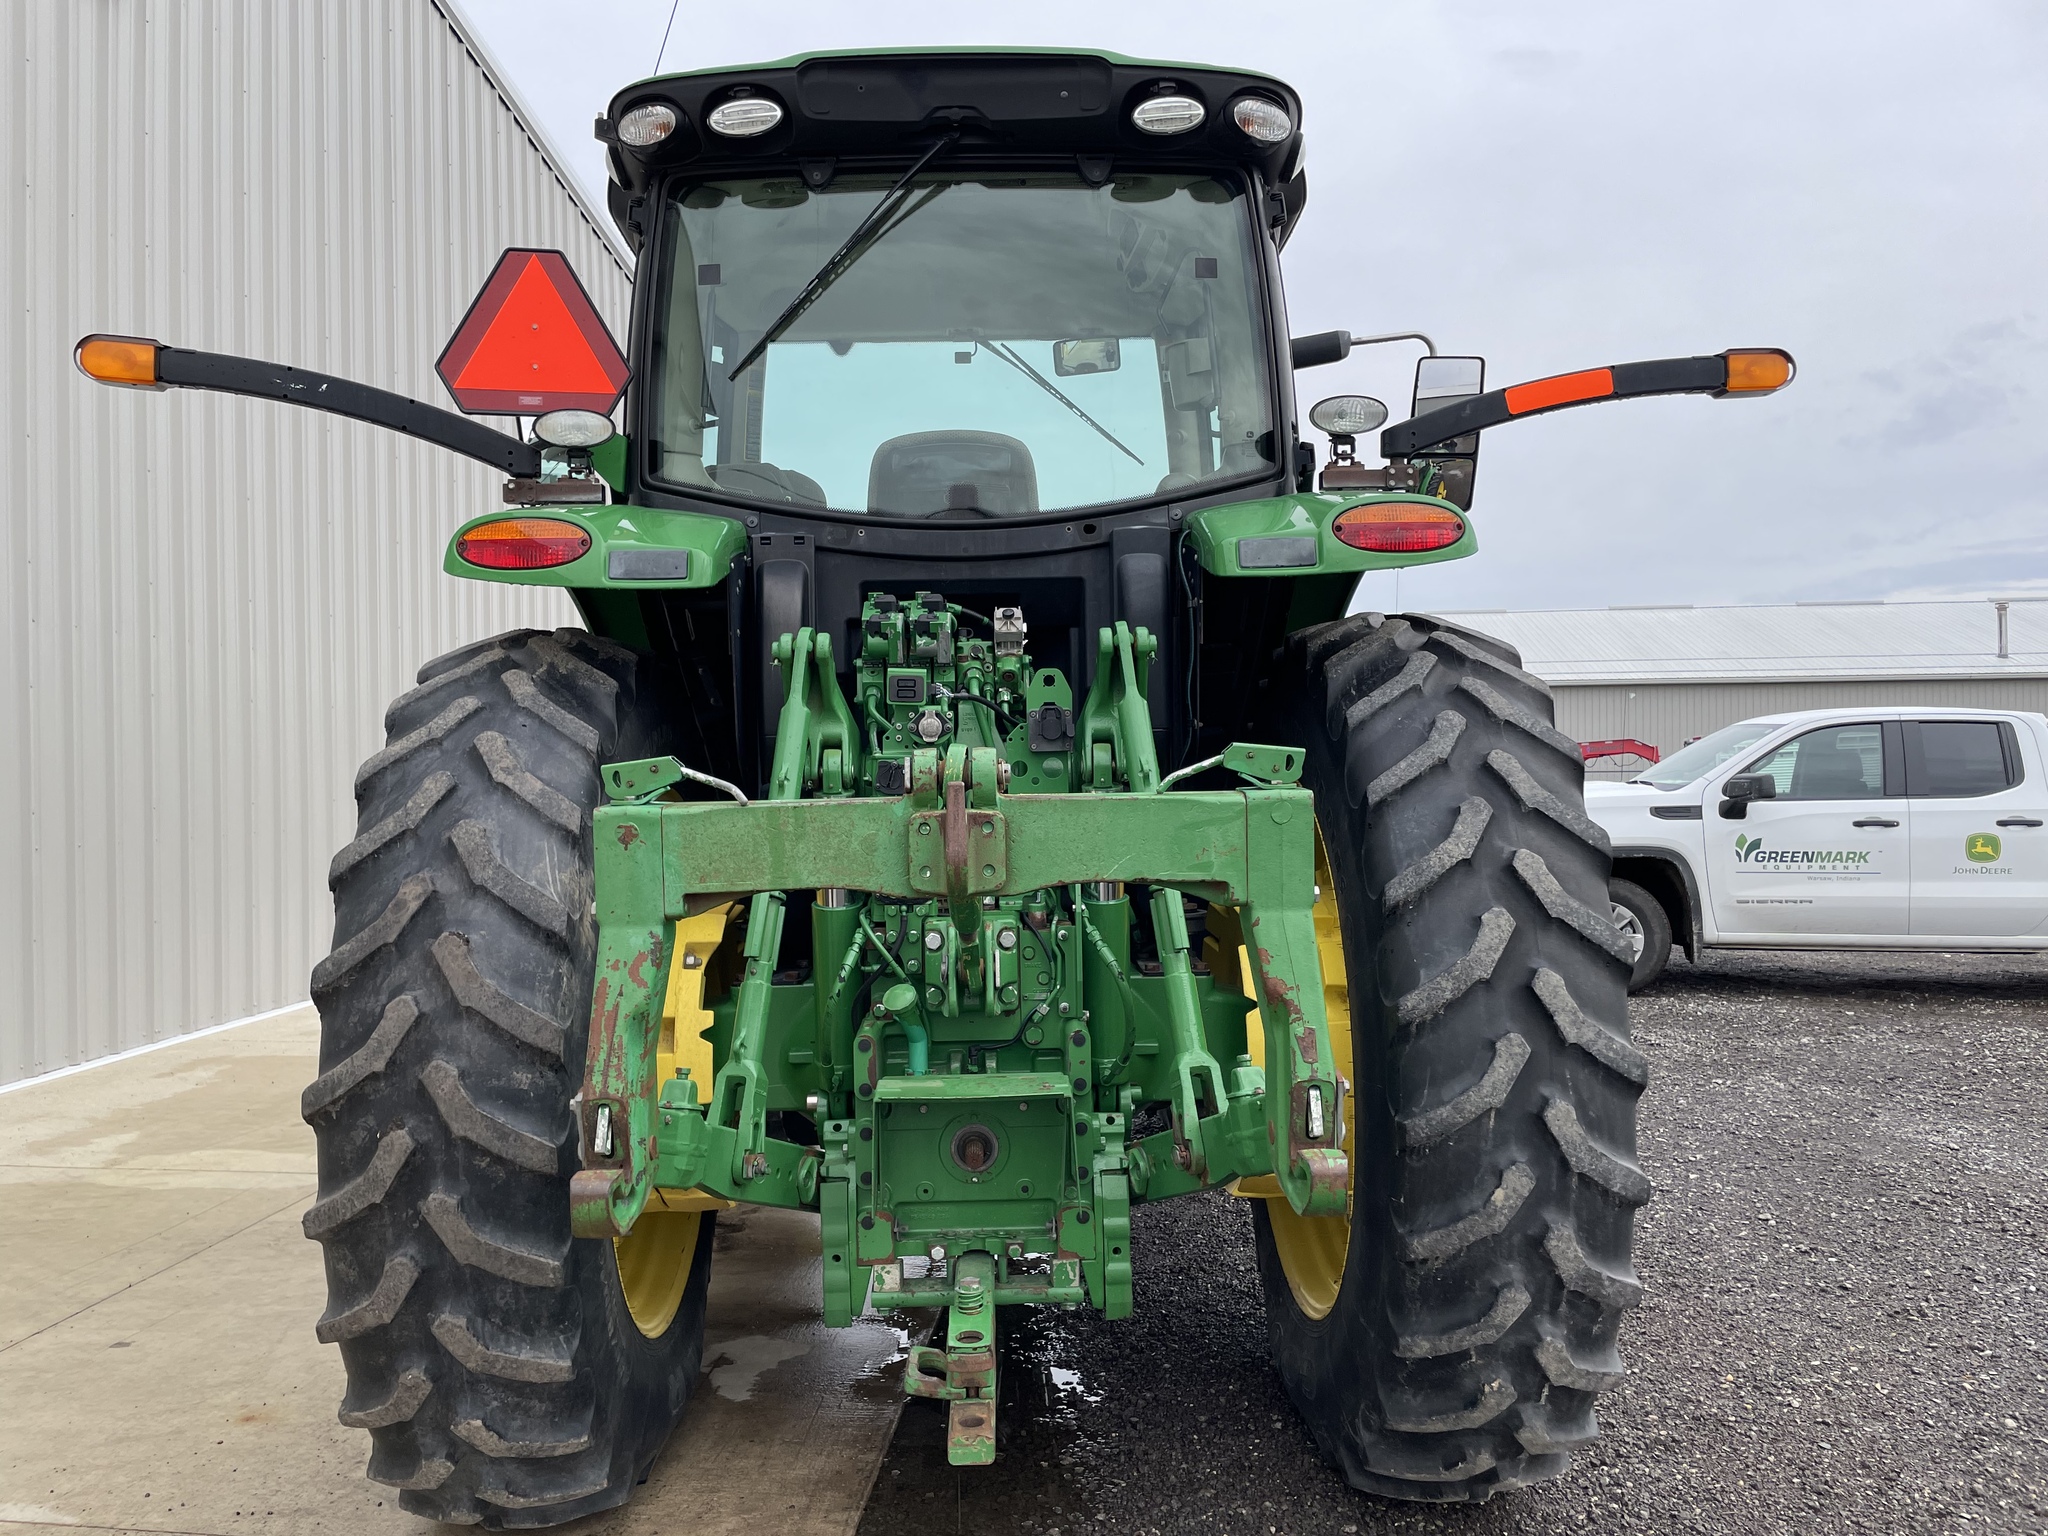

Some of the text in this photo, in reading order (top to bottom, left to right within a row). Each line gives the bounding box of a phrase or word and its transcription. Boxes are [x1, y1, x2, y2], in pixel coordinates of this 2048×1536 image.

[1754, 850, 1871, 864] GREENMARK
[1952, 866, 2013, 875] JOHN DEERE
